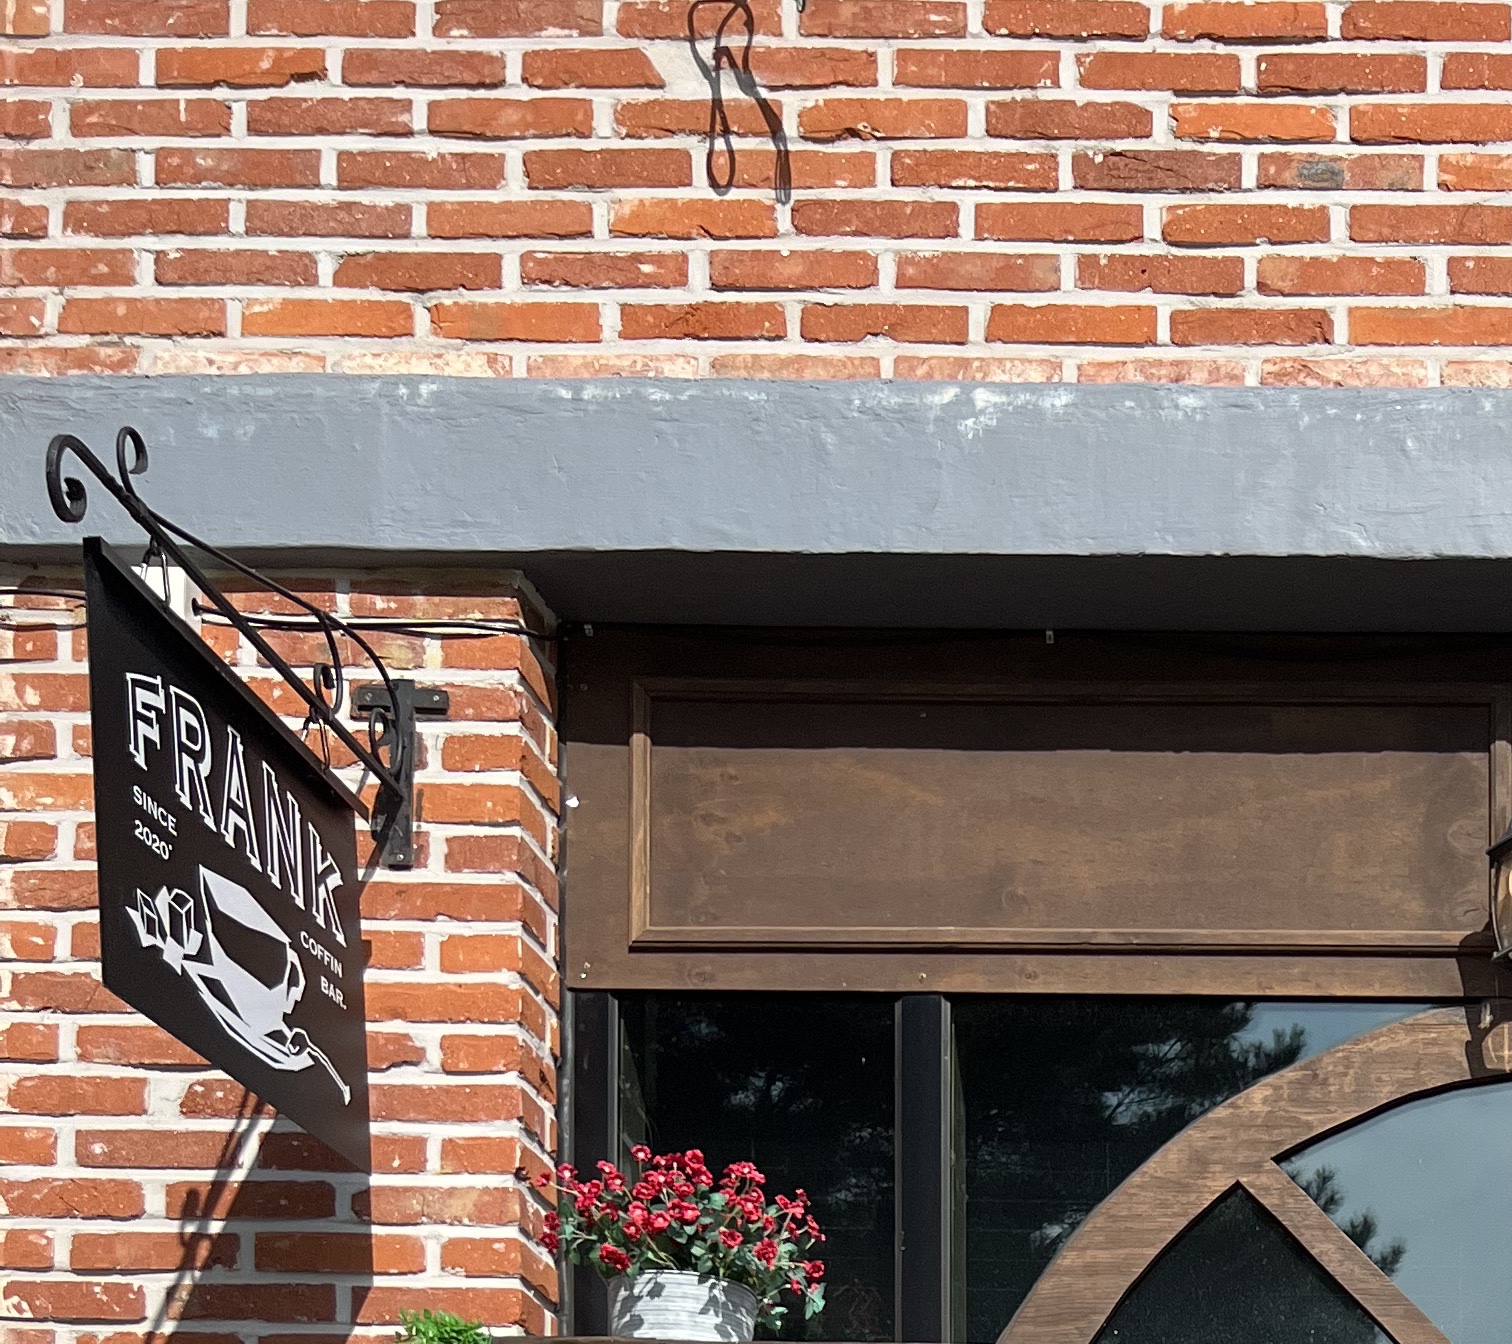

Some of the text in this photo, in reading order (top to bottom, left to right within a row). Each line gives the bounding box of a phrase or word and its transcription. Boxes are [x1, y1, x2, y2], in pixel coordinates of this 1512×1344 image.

[125, 671, 347, 948] FRANK
[132, 784, 178, 837] SINCE
[300, 931, 343, 978] COFFIN
